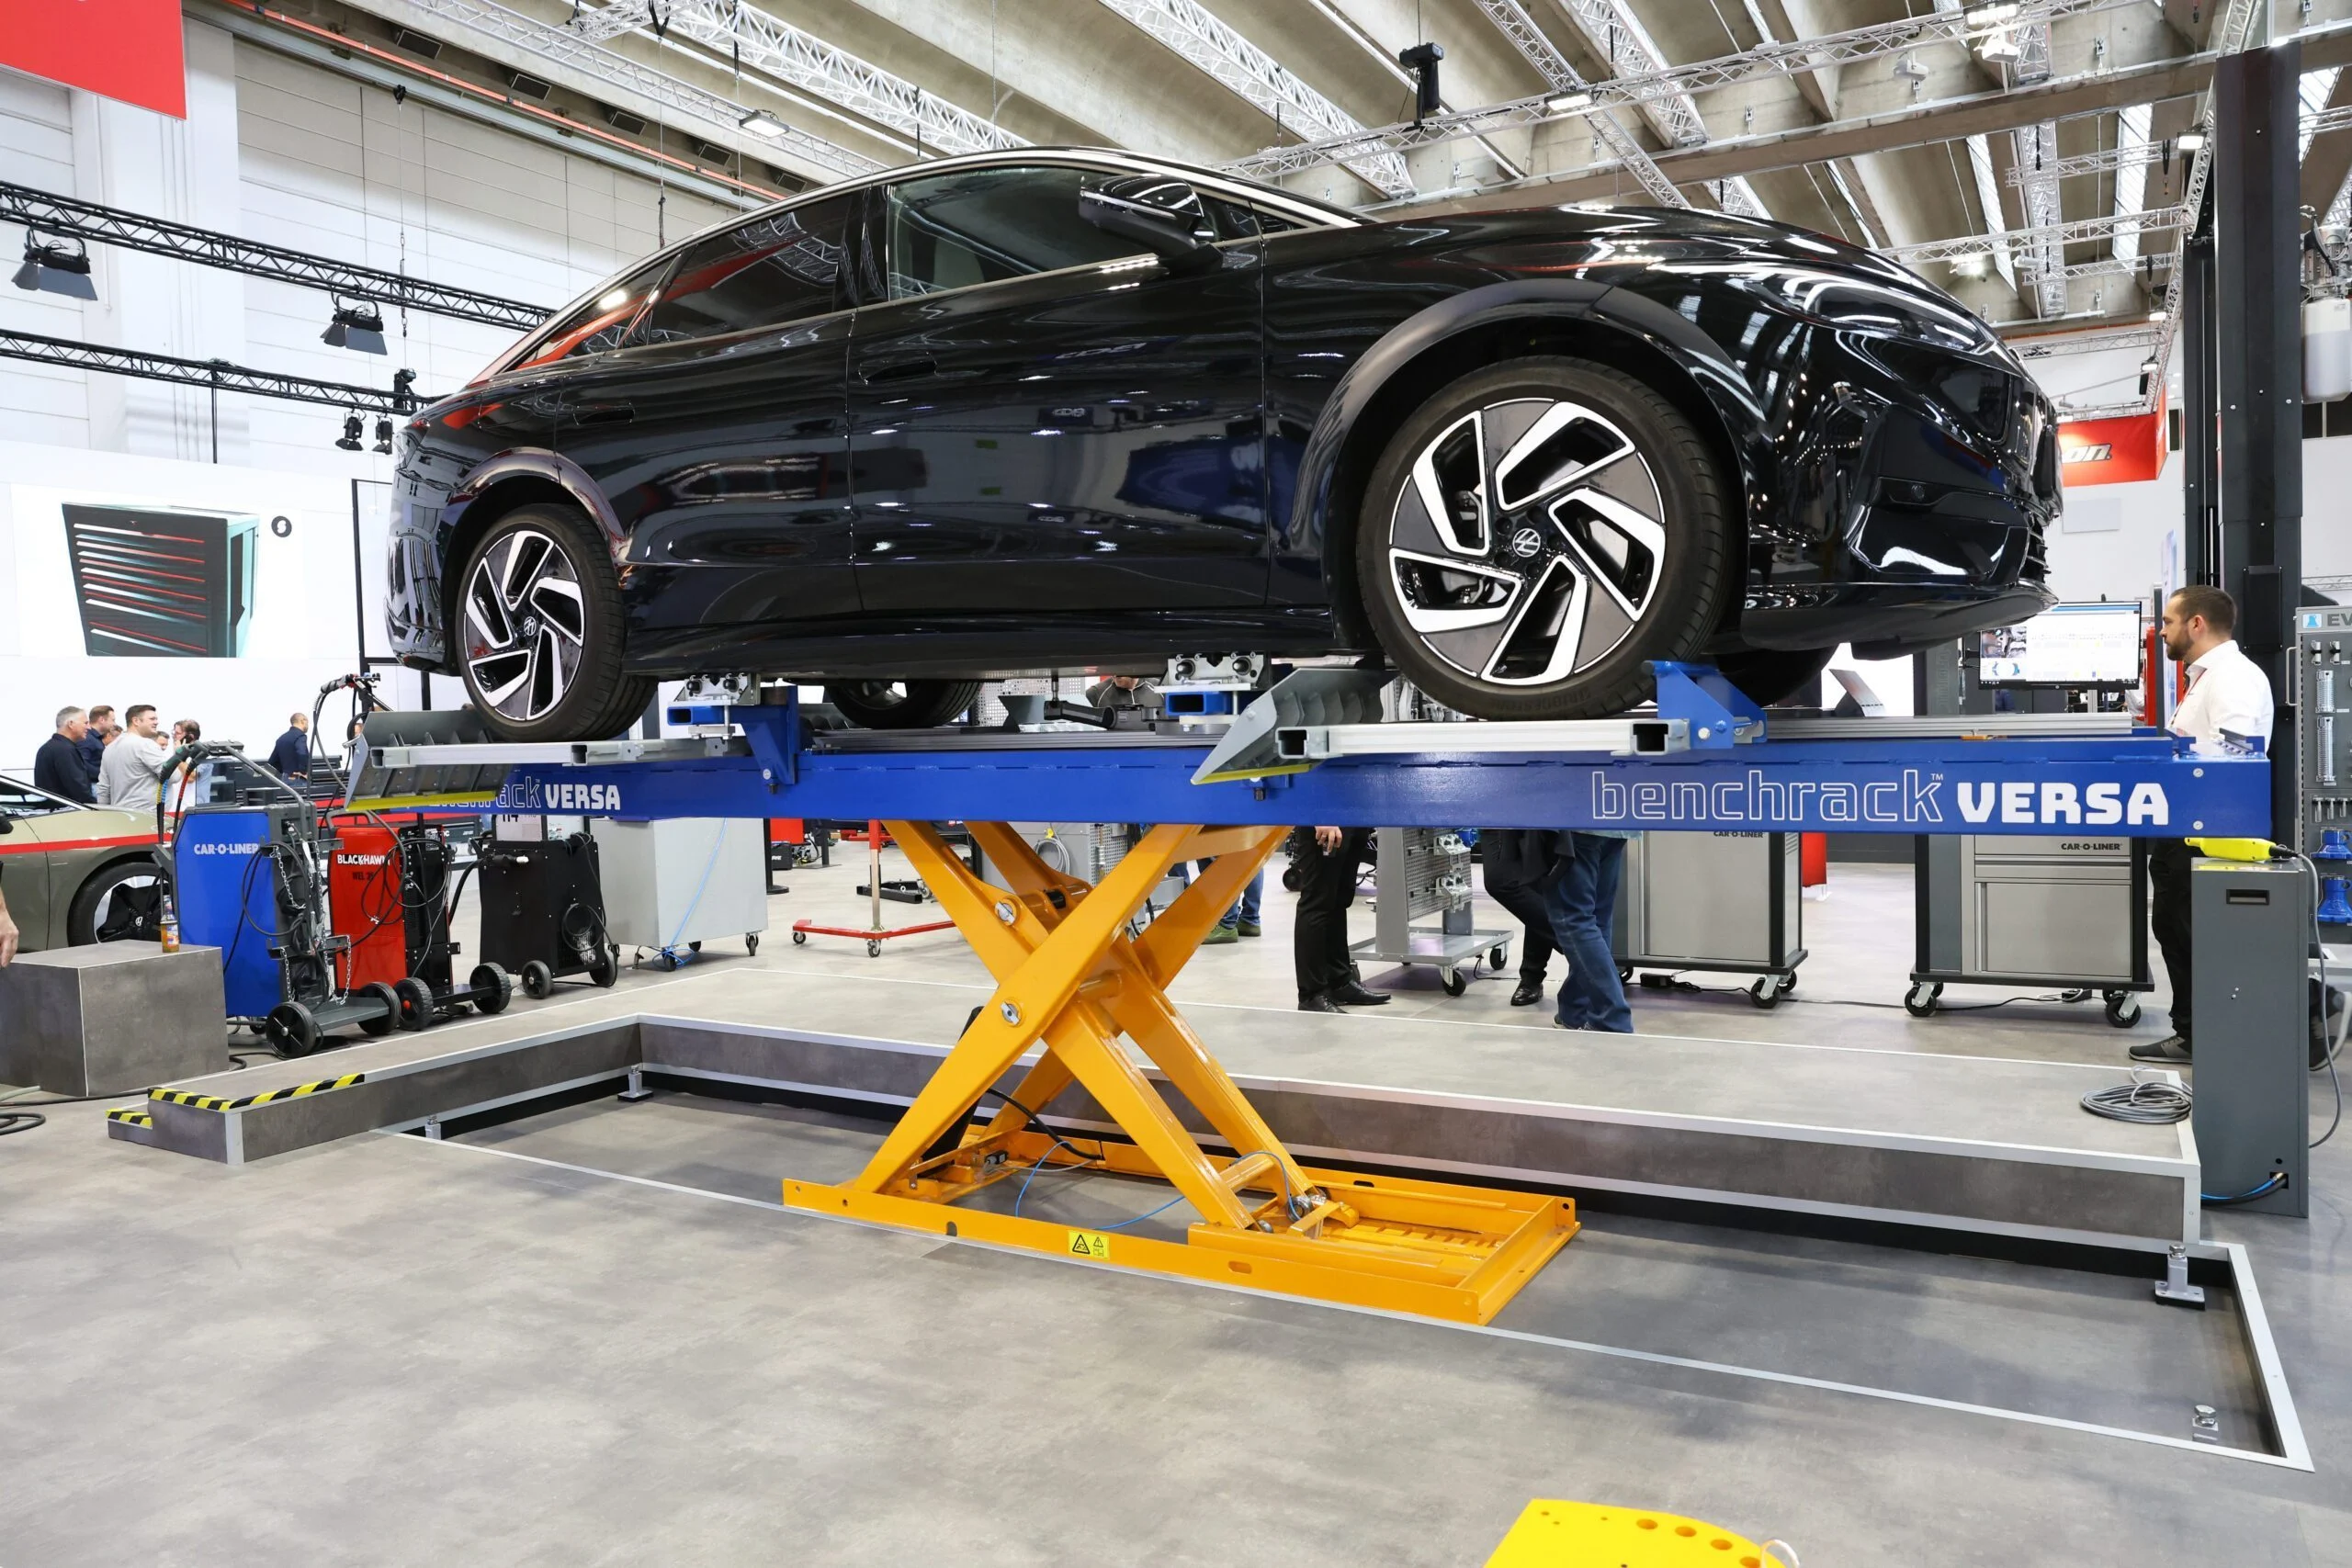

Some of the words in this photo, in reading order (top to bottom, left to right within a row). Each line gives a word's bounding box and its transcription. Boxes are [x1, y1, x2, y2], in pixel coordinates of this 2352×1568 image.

[544, 784, 621, 810] VERSA
[1957, 782, 2169, 826] VERSA
[2061, 842, 2121, 851] CAR-O-LINER
